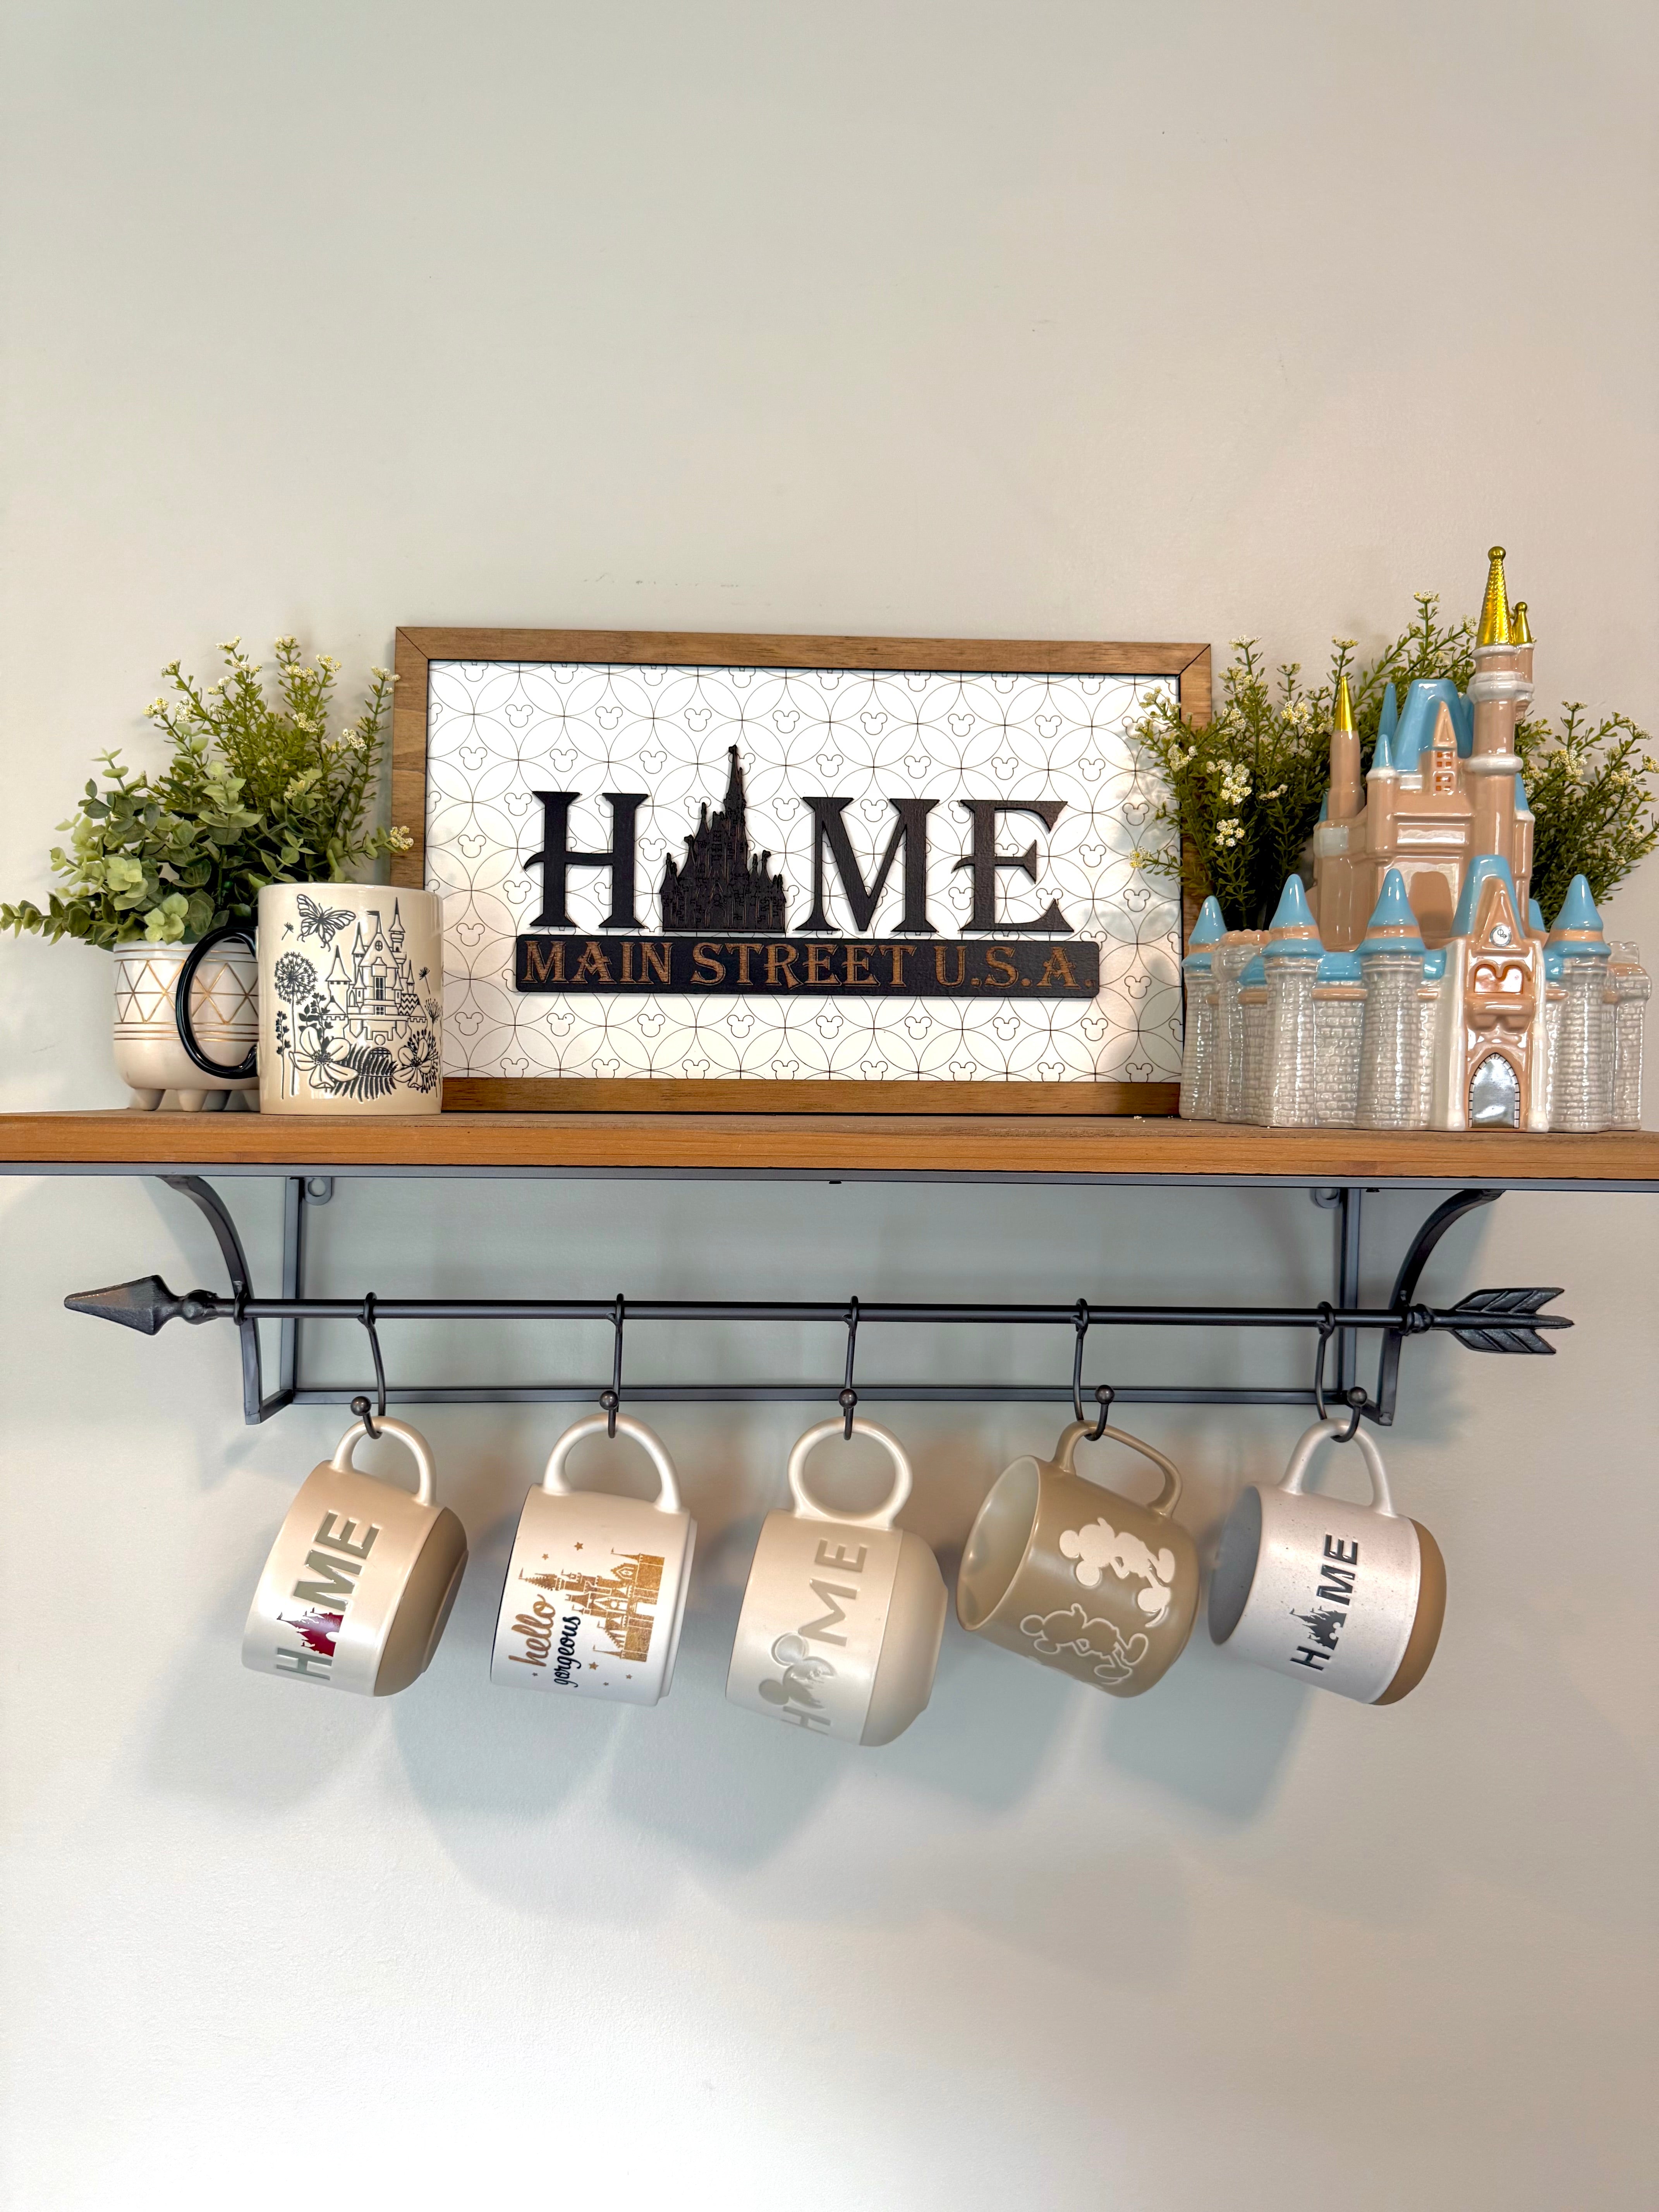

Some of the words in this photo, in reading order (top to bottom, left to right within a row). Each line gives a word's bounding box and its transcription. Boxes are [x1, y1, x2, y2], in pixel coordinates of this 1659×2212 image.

[524, 790, 1075, 933] HME
[522, 940, 673, 986] MAIN
[691, 943, 917, 990] STREET
[276, 1510, 383, 1681] HME
[508, 1594, 556, 1667] hello
[554, 1615, 581, 1688] gorgeous
[758, 1538, 868, 1736] HME
[1289, 1533, 1358, 1671] HME
